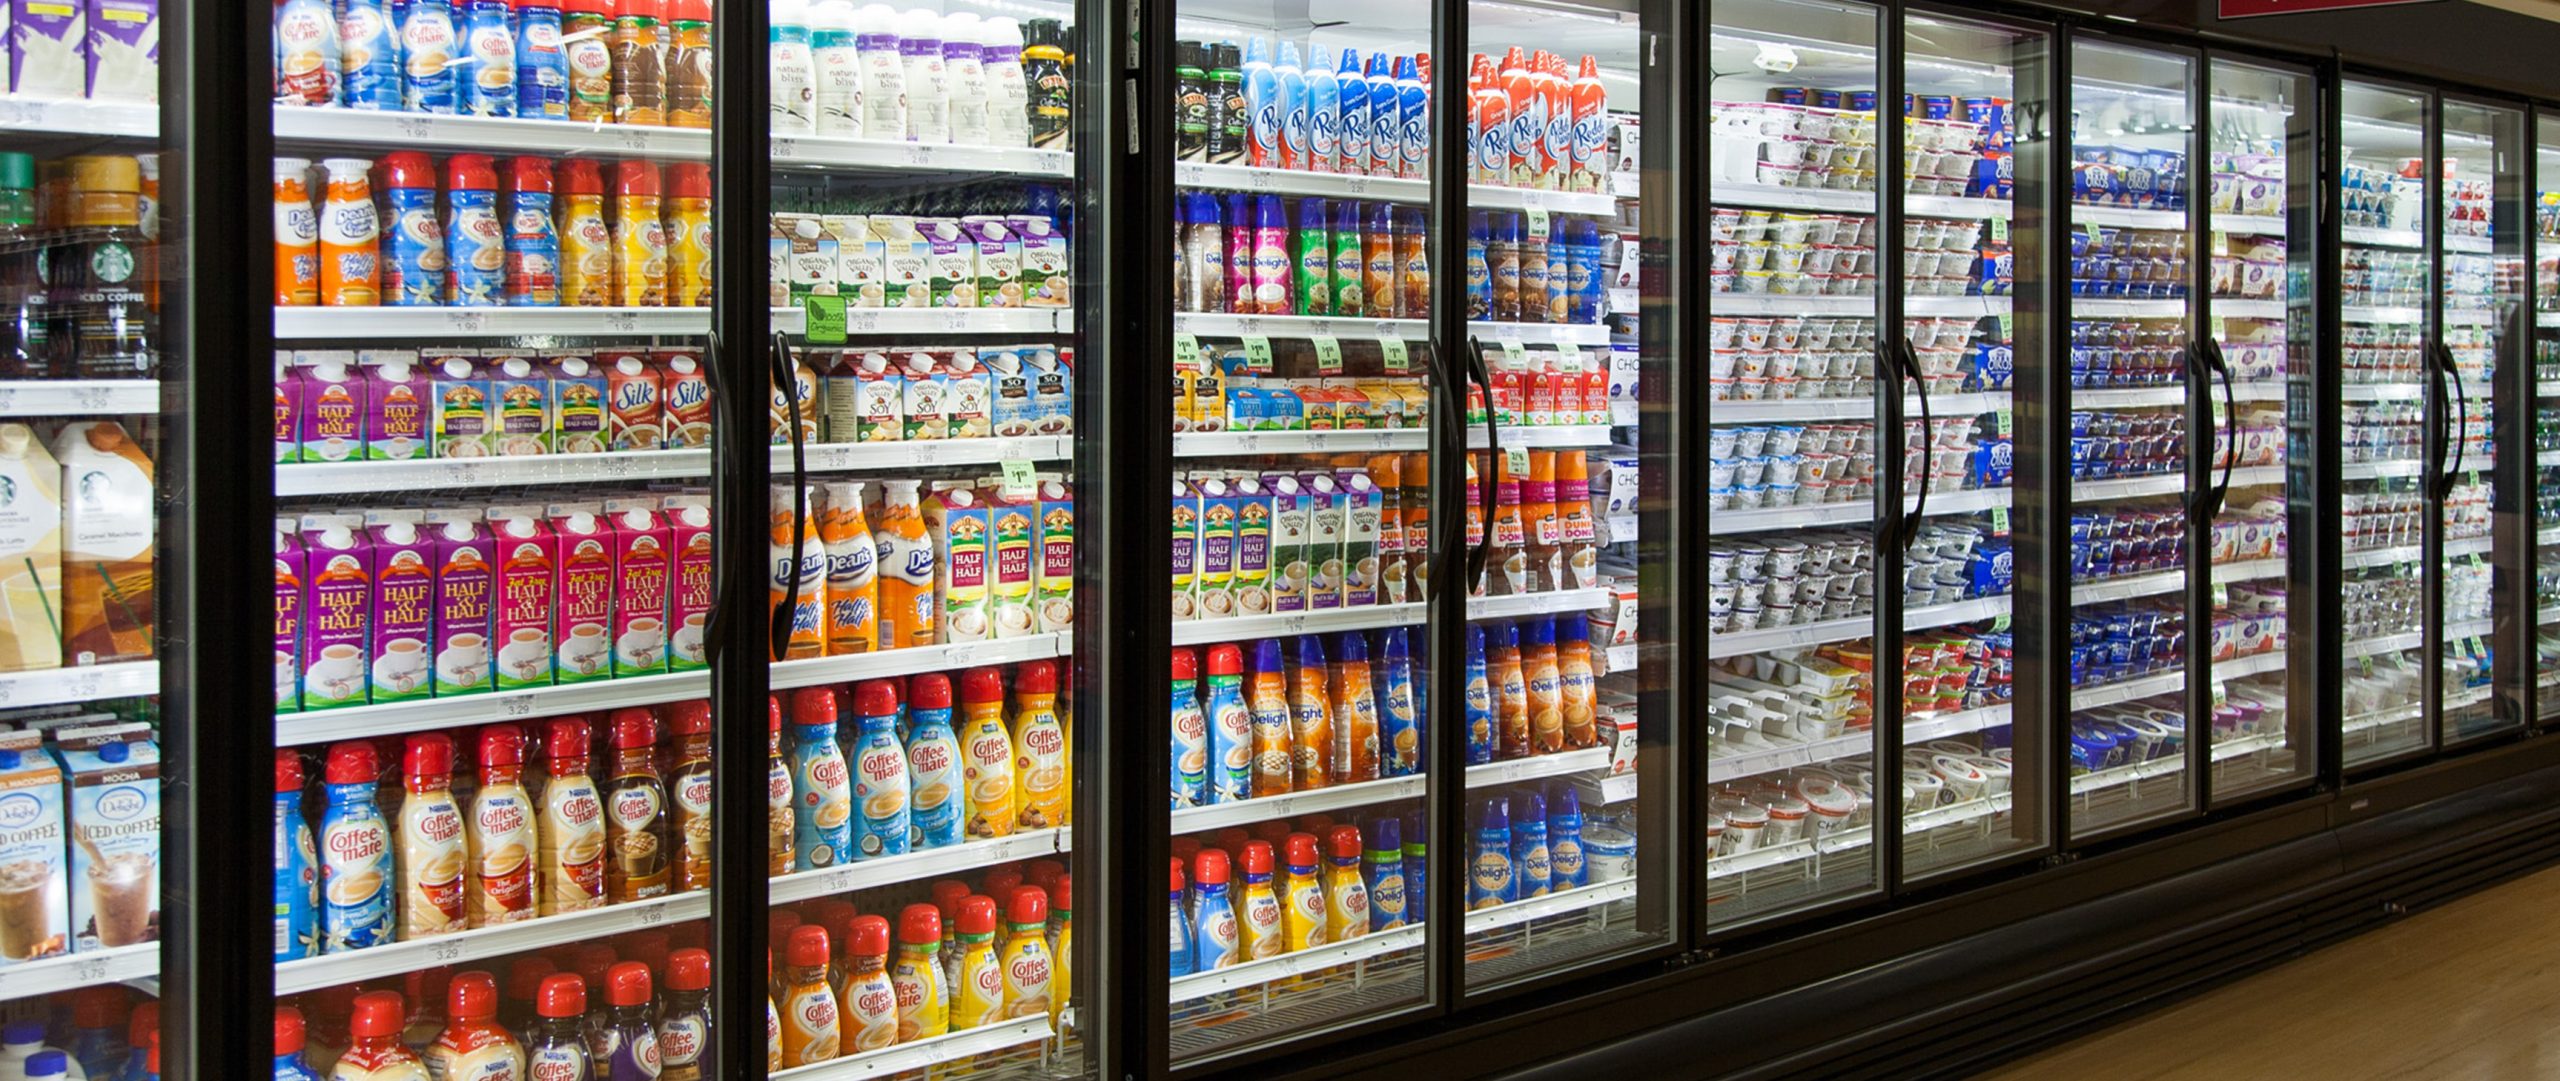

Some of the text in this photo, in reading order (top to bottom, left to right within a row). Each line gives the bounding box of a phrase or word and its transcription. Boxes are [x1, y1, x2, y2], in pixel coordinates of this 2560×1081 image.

[2085, 177, 2110, 189] OIKOS
[2126, 178, 2151, 190] OIKOS
[2244, 196, 2265, 208] GREEK
[798, 256, 831, 269] ORGANIC
[846, 257, 878, 270] ORGANIC
[892, 257, 924, 269] ORGANIC
[938, 257, 968, 269] ORGANIC
[986, 257, 1016, 269] ORGANIC
[1029, 250, 1060, 263] ORGANIC
[1033, 258, 1058, 268] VALLEY
[1253, 256, 1289, 270] Delight
[801, 264, 827, 274] VALLEY
[849, 265, 874, 275] VALLEY
[896, 265, 920, 274] VALLEY
[942, 264, 966, 274] VALLEY
[990, 264, 1013, 274] VALLEY
[107, 294, 145, 303] COFFEE
[456, 322, 478, 332] 1.99
[615, 323, 635, 332] 1.99
[810, 321, 844, 335] Organic
[857, 320, 875, 330] 2.69
[1006, 379, 1021, 387] SO
[1043, 374, 1058, 382] SO
[616, 382, 654, 411] Silk
[671, 381, 707, 409] Silk
[866, 384, 893, 396] ORGANIC
[869, 401, 892, 415] SOY
[917, 401, 938, 414] SOY
[960, 400, 980, 412] SOY
[319, 408, 354, 421] HALF
[385, 408, 418, 421] HALF
[319, 423, 354, 435] HALF
[385, 423, 418, 435] HALF
[1280, 514, 1306, 527] ORGANIC
[1316, 513, 1342, 526] ORGANIC
[1352, 511, 1379, 524] ORGANIC
[1355, 517, 1377, 530] VALLEY
[1283, 520, 1305, 532] VALLEY
[1319, 519, 1340, 531] VALLEY
[1001, 550, 1027, 561] HALF
[1047, 544, 1071, 556] HALF
[1208, 547, 1230, 558] HALF
[1244, 545, 1265, 556] HALF
[825, 546, 872, 574] Dean's
[954, 553, 981, 565] HALF
[1047, 558, 1071, 571] HALF
[1208, 559, 1230, 571] HALF
[1243, 557, 1265, 569] HALF
[954, 566, 981, 579] HALF
[1001, 563, 1027, 575] HALF
[446, 581, 489, 598] HALF
[568, 580, 608, 596] HALF
[625, 575, 663, 591] HALF
[384, 586, 429, 602] HALF
[507, 584, 549, 600] HALF
[320, 591, 367, 608] HALF
[625, 596, 663, 612] HALF
[446, 603, 489, 620] HALF
[508, 605, 549, 622] HALF
[568, 600, 608, 616] HALF
[320, 615, 366, 631] HALF
[384, 608, 429, 625] HALF
[71, 686, 98, 698] 5.29
[508, 705, 530, 715] 3.29
[1026, 728, 1060, 750] Coffee
[973, 736, 1006, 759] Coffee
[1036, 740, 1063, 757] mate
[911, 743, 944, 767] Coffee
[983, 747, 1009, 767] mate
[813, 759, 846, 781] Coffee
[863, 753, 901, 775] Coffee
[918, 755, 949, 778] mate
[103, 772, 141, 784] MOCHA
[873, 763, 904, 781] mate
[562, 796, 597, 818] Coffee
[618, 798, 651, 816] Coffee
[479, 804, 520, 828] Coffee
[573, 808, 601, 825] mate
[626, 808, 653, 822] mate
[118, 817, 161, 843] COFFEE
[421, 814, 456, 835] Coffee
[489, 816, 524, 837] mate
[13, 828, 60, 850] COFFEE
[330, 827, 378, 854] Coffee
[432, 827, 461, 843] mate
[342, 843, 383, 863] mate
[1551, 853, 1583, 867] Delight
[1473, 865, 1512, 882] Delight
[642, 913, 662, 924] 3.99
[1253, 904, 1278, 922] Coffee
[436, 949, 459, 960] 3.29
[1011, 956, 1048, 976] Coffee
[80, 969, 106, 980] 3.79
[1021, 966, 1050, 987] mate
[858, 991, 890, 1010] Coffee
[805, 1001, 833, 1022] Coffee
[868, 1002, 896, 1018] mate
[815, 1012, 836, 1030] mate
[660, 1032, 695, 1050] Coffee
[663, 1042, 696, 1057] mate
[534, 1059, 576, 1080] Coffee
